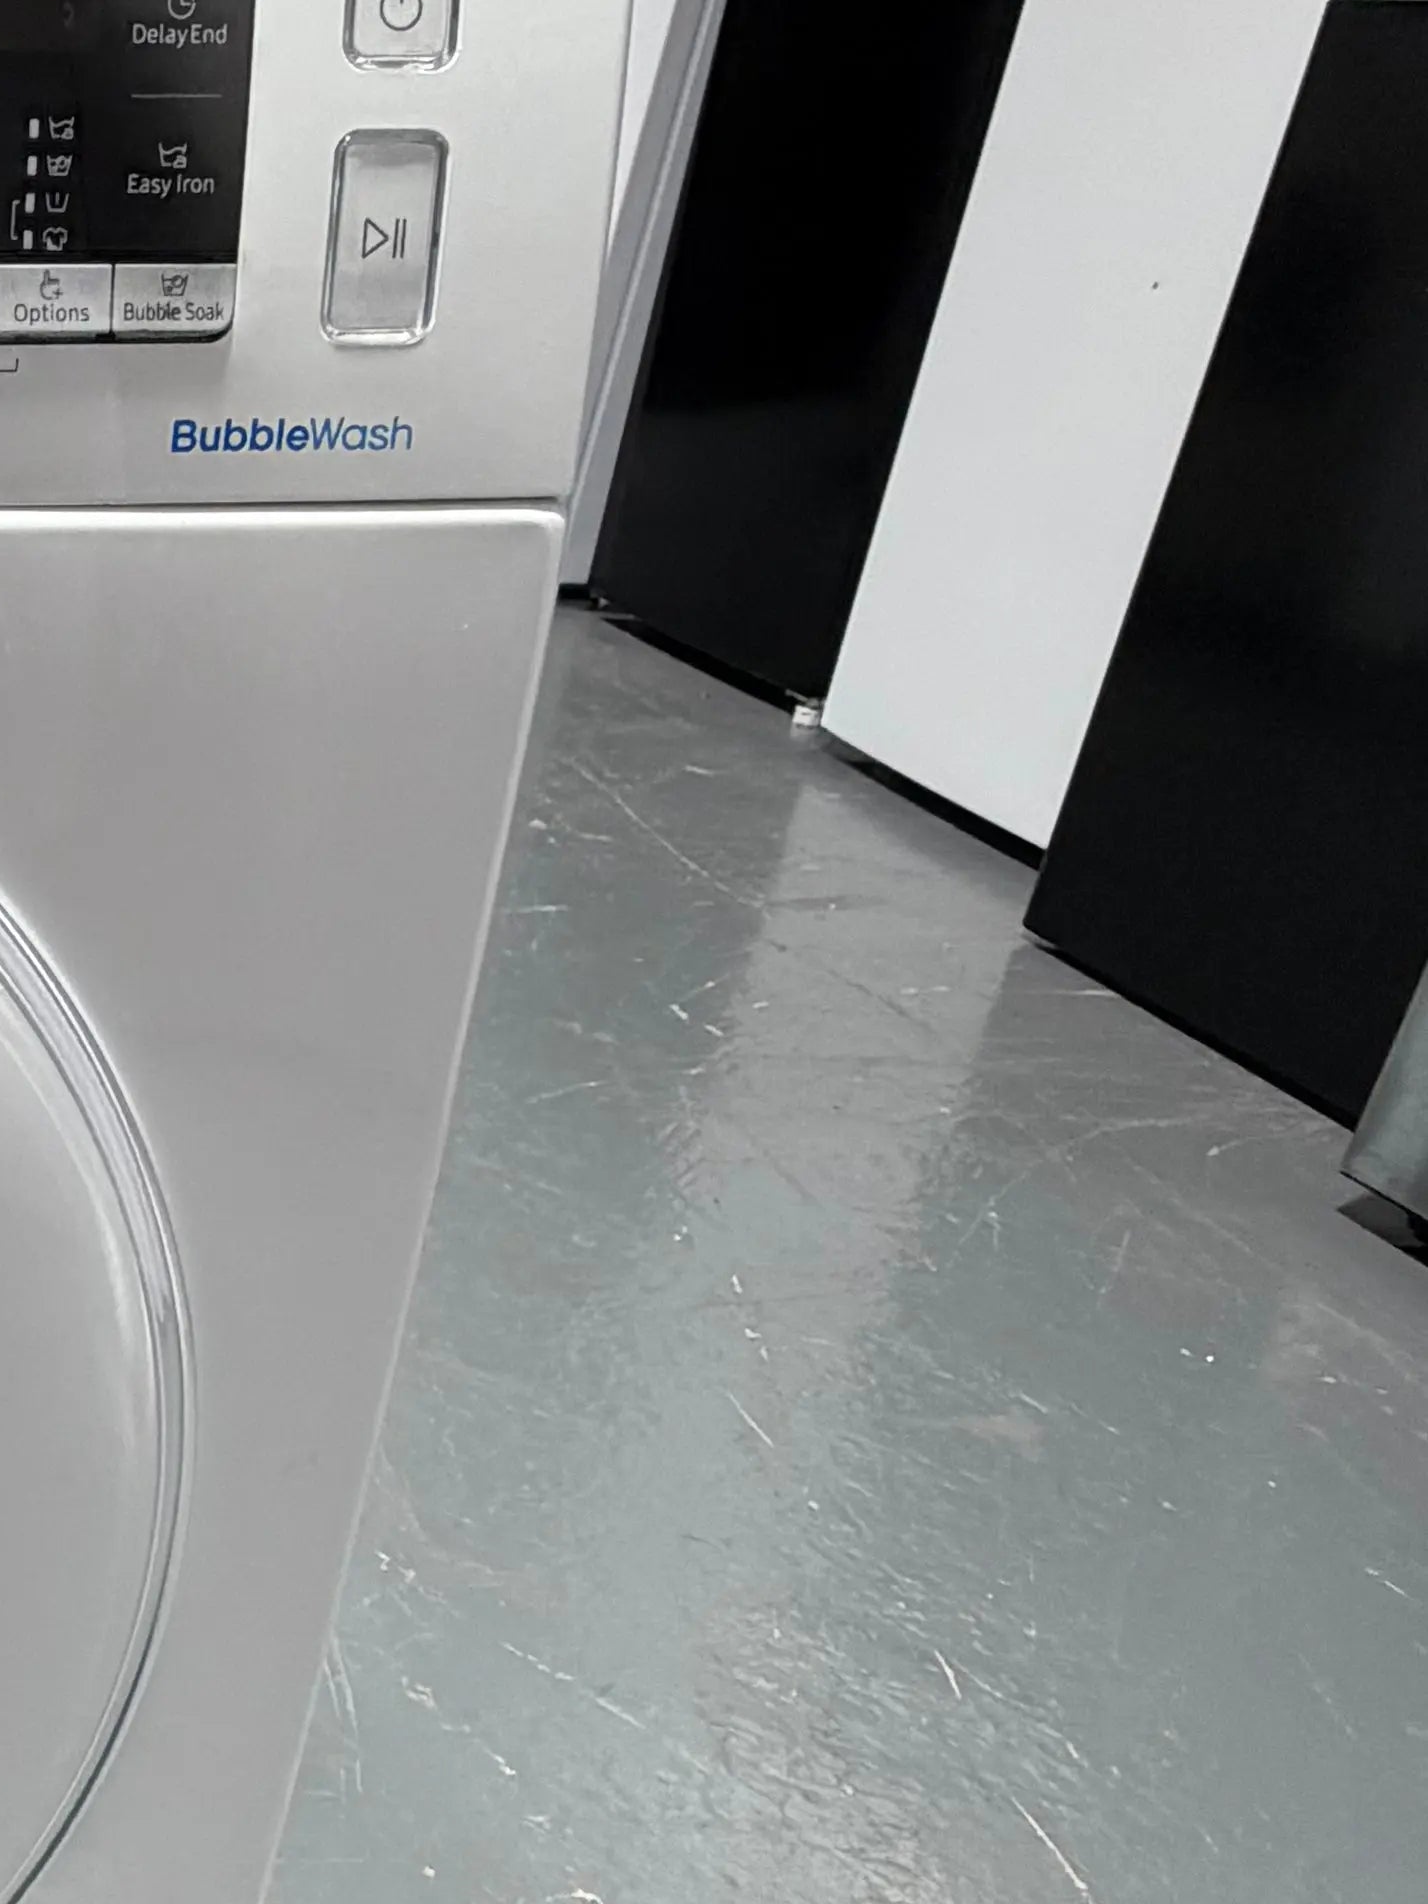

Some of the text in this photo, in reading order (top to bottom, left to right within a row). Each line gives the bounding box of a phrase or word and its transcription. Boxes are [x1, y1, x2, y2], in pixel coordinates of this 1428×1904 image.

[132, 23, 228, 49] Delay End
[126, 172, 215, 199] Easy Iron
[14, 303, 90, 327] Options
[123, 301, 225, 322] Bubble Soak
[171, 416, 413, 453] BubbleWash
